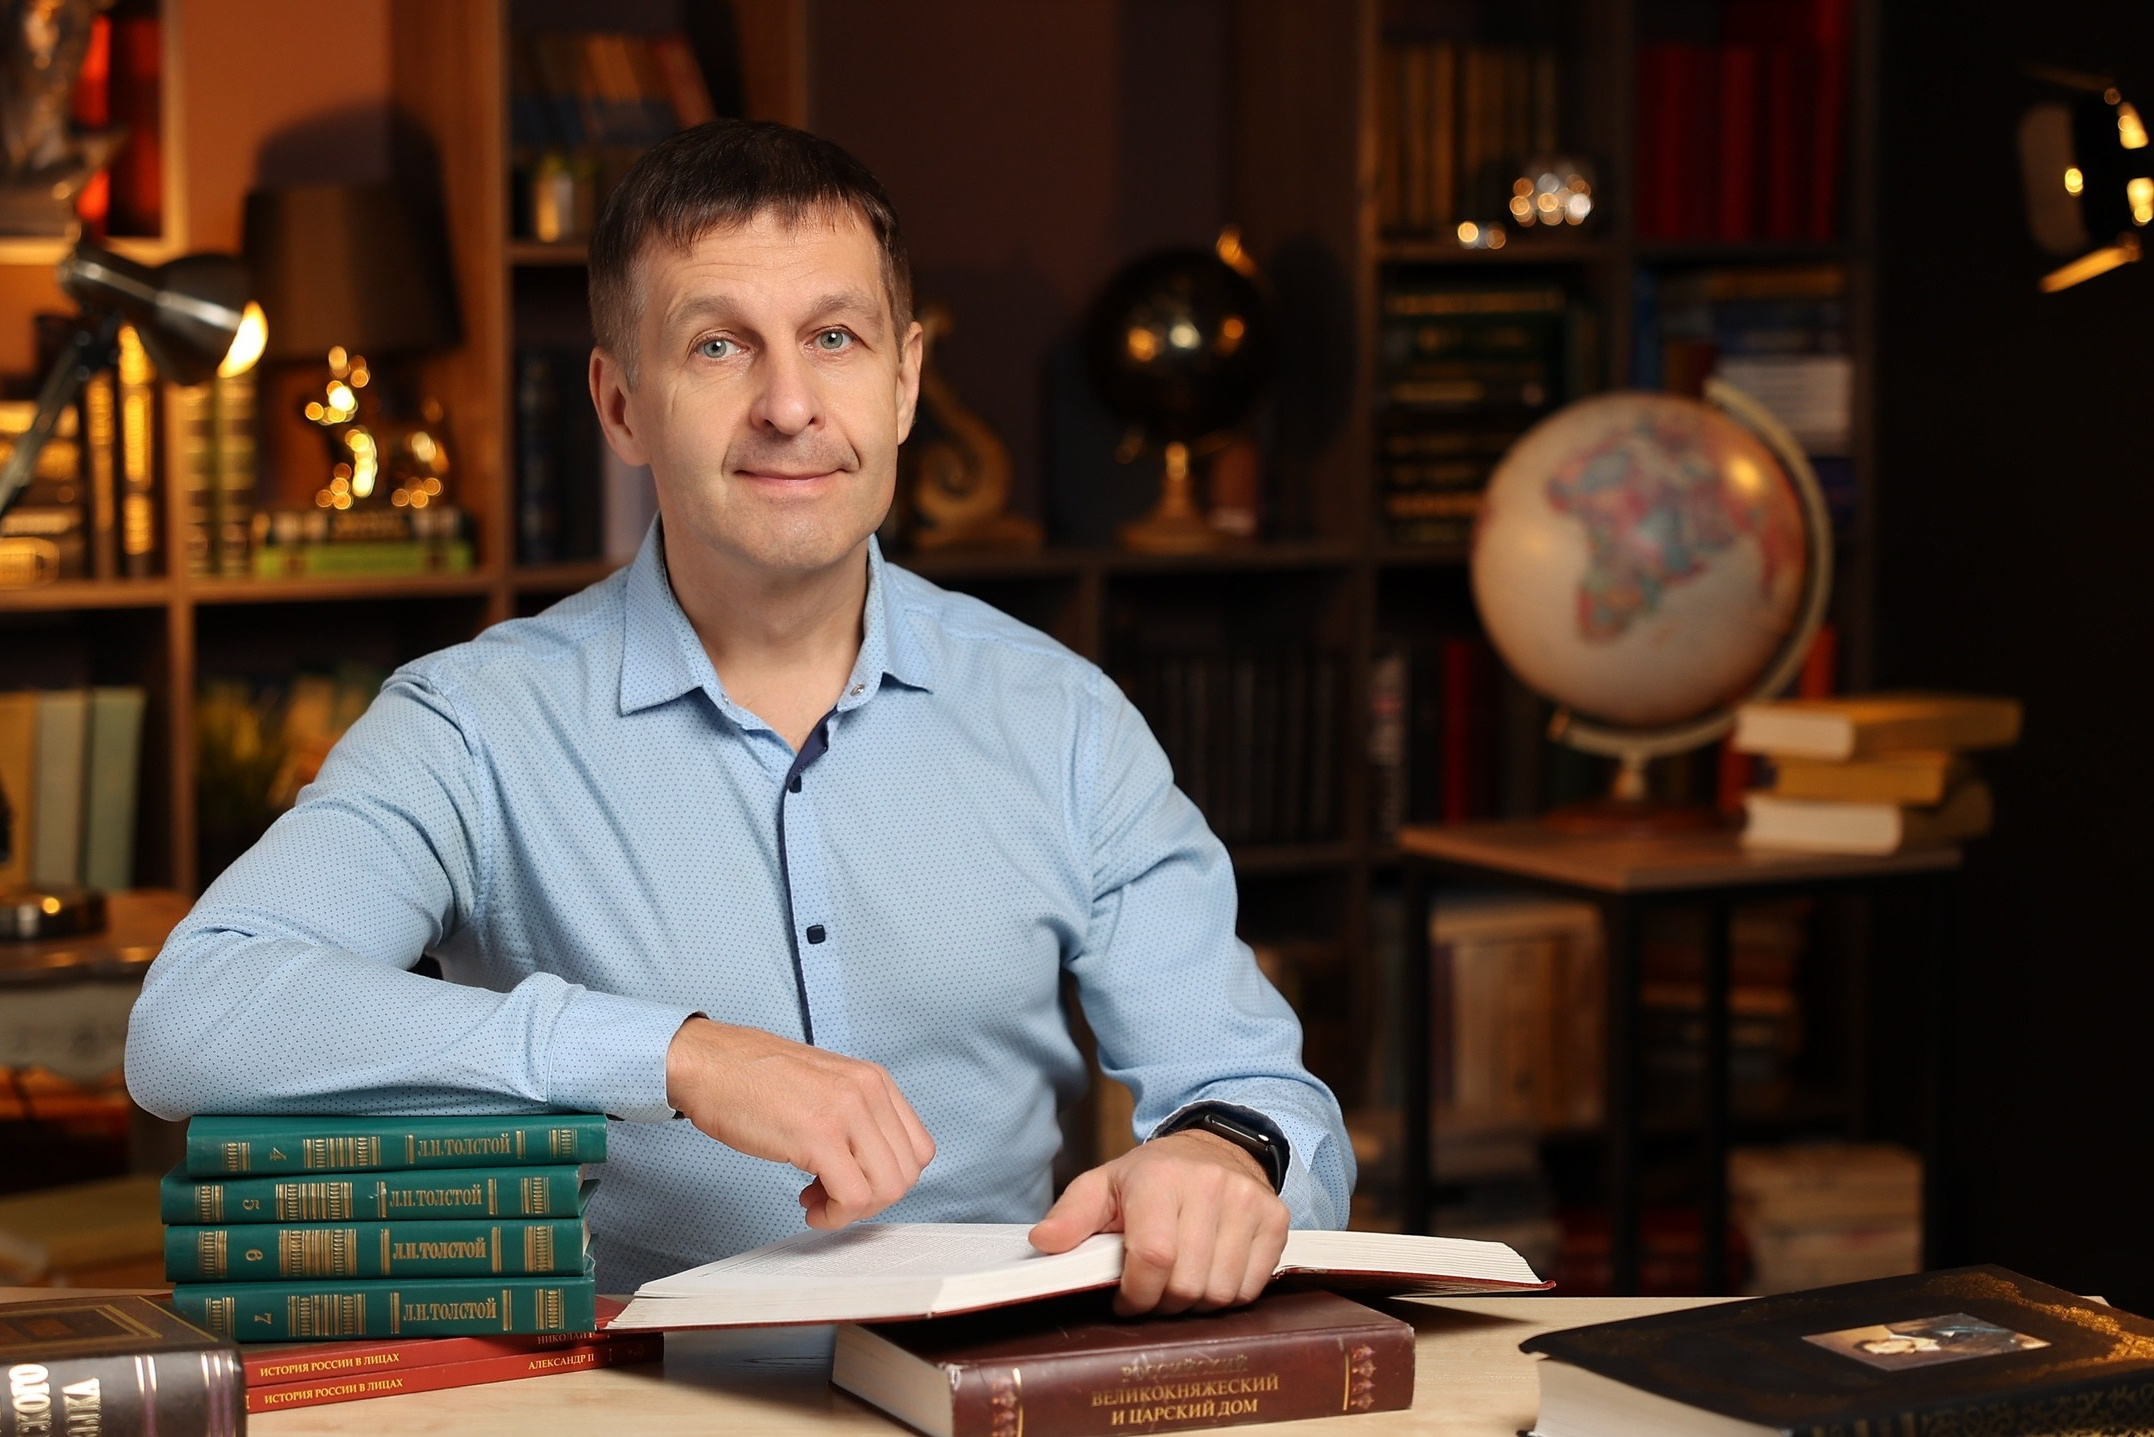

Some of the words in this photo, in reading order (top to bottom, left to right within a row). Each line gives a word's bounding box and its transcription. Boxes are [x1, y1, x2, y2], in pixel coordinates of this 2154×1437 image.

[270, 1147, 287, 1161] 4
[243, 1199, 260, 1210] 5
[245, 1249, 264, 1262] 6
[254, 1312, 272, 1325] 7
[260, 1363, 309, 1377] ИСТОРИЯ
[311, 1358, 353, 1374] РОССИИ
[355, 1357, 362, 1366] В
[363, 1352, 400, 1366] ЛИЦАХ
[528, 1354, 586, 1370] АЛЕКСАНДР
[588, 1353, 594, 1362] II
[264, 1388, 313, 1404] ИСТОРИЯ
[315, 1383, 357, 1398] РОССИИ
[359, 1382, 366, 1392] В
[367, 1378, 403, 1392] ЛИЦАХ
[1091, 1373, 1279, 1407] ВЕЛИКОКНЯЖЕСКИЙ
[1111, 1410, 1125, 1426] И
[1129, 1399, 1215, 1425] ЦАРСКИЙ
[1217, 1398, 1259, 1416] ДОМ
